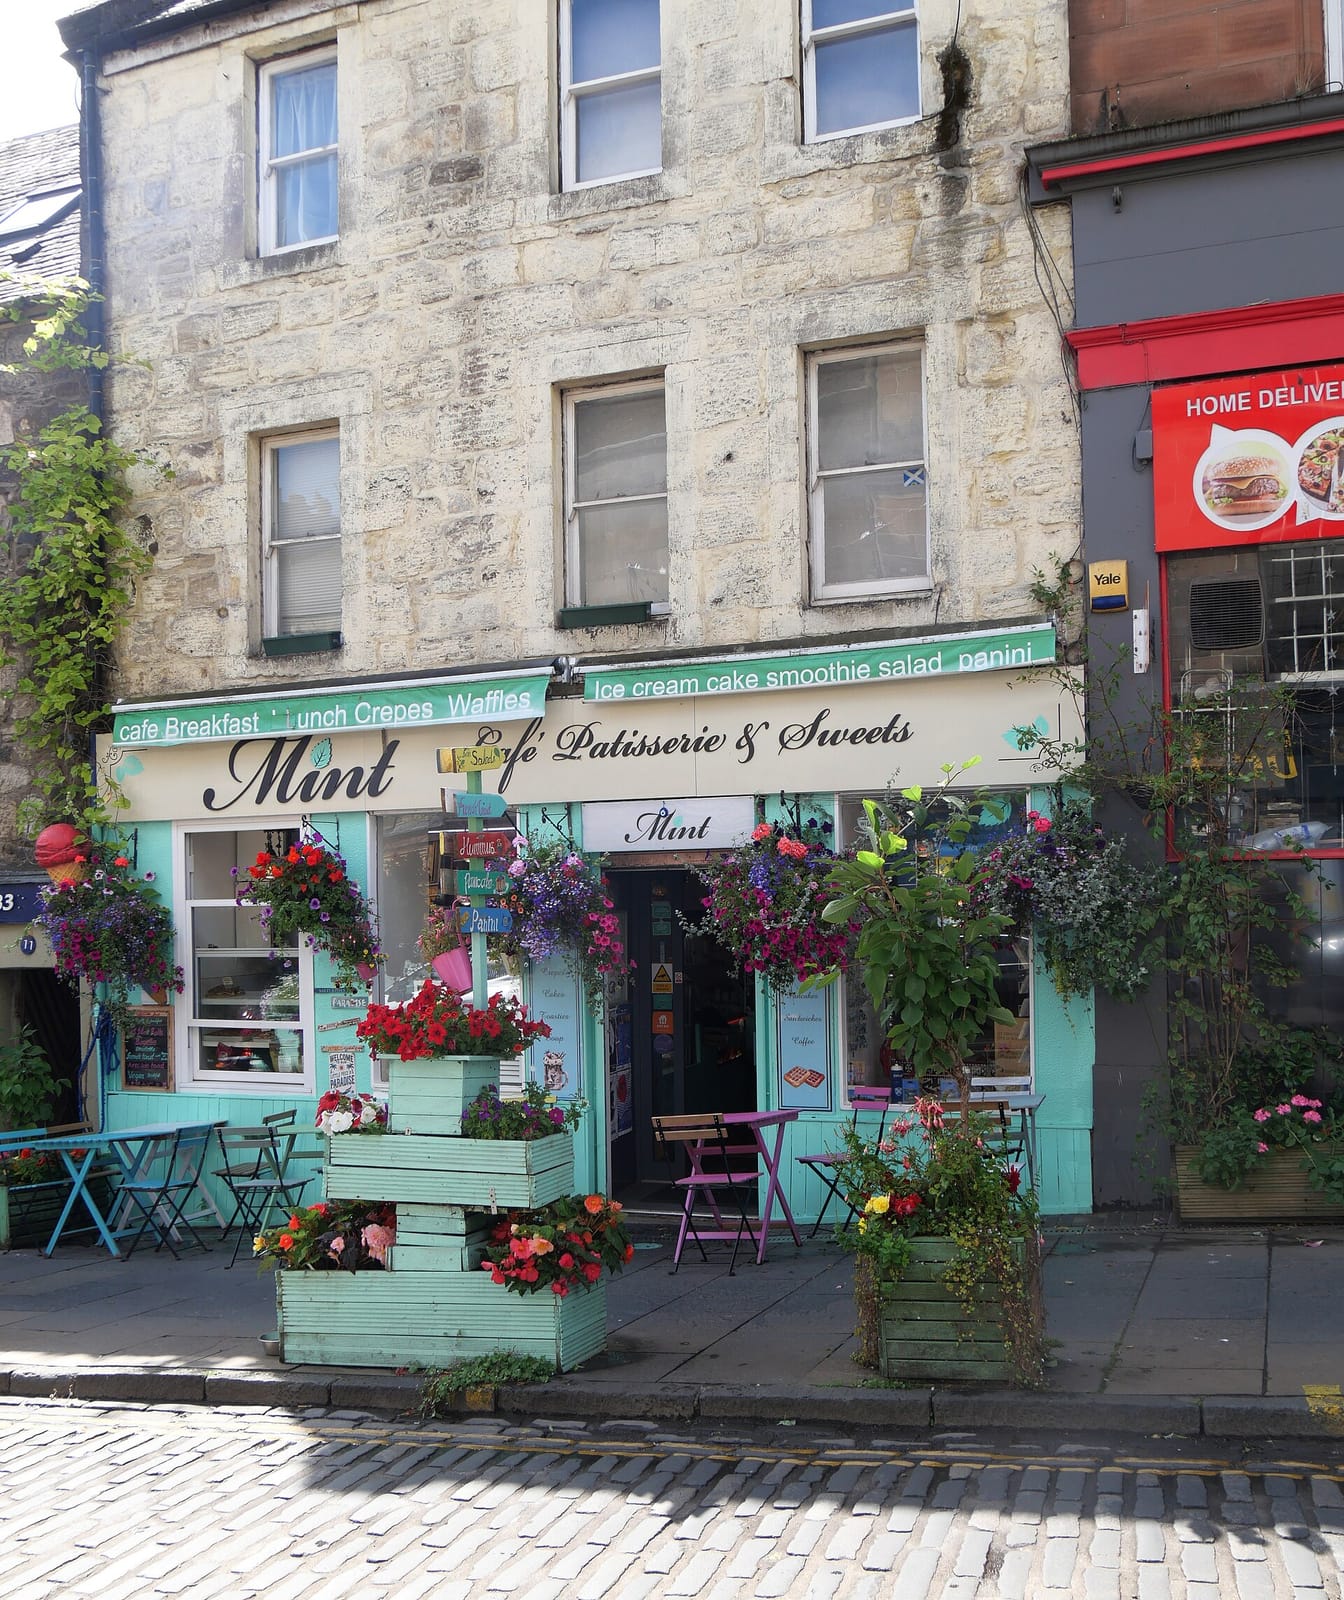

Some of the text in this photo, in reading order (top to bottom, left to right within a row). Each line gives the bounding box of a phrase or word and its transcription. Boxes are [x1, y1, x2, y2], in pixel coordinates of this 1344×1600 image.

[1186, 380, 1344, 417] HOME DELIVE
[1094, 571, 1121, 585] Yale
[595, 642, 1033, 701] Ice cream cake smoothie salad panini
[119, 718, 158, 741] cafe
[164, 711, 260, 738] Breakfast
[354, 701, 434, 725] Crepes
[447, 689, 531, 717] Waffles
[552, 721, 726, 762] Patisserie
[736, 723, 769, 764] &
[779, 708, 914, 750] Sweets
[203, 735, 400, 811] Mint
[625, 811, 711, 844] Mint
[460, 836, 496, 856] Hummus
[0, 893, 14, 911] 3
[24, 940, 33, 950] 11
